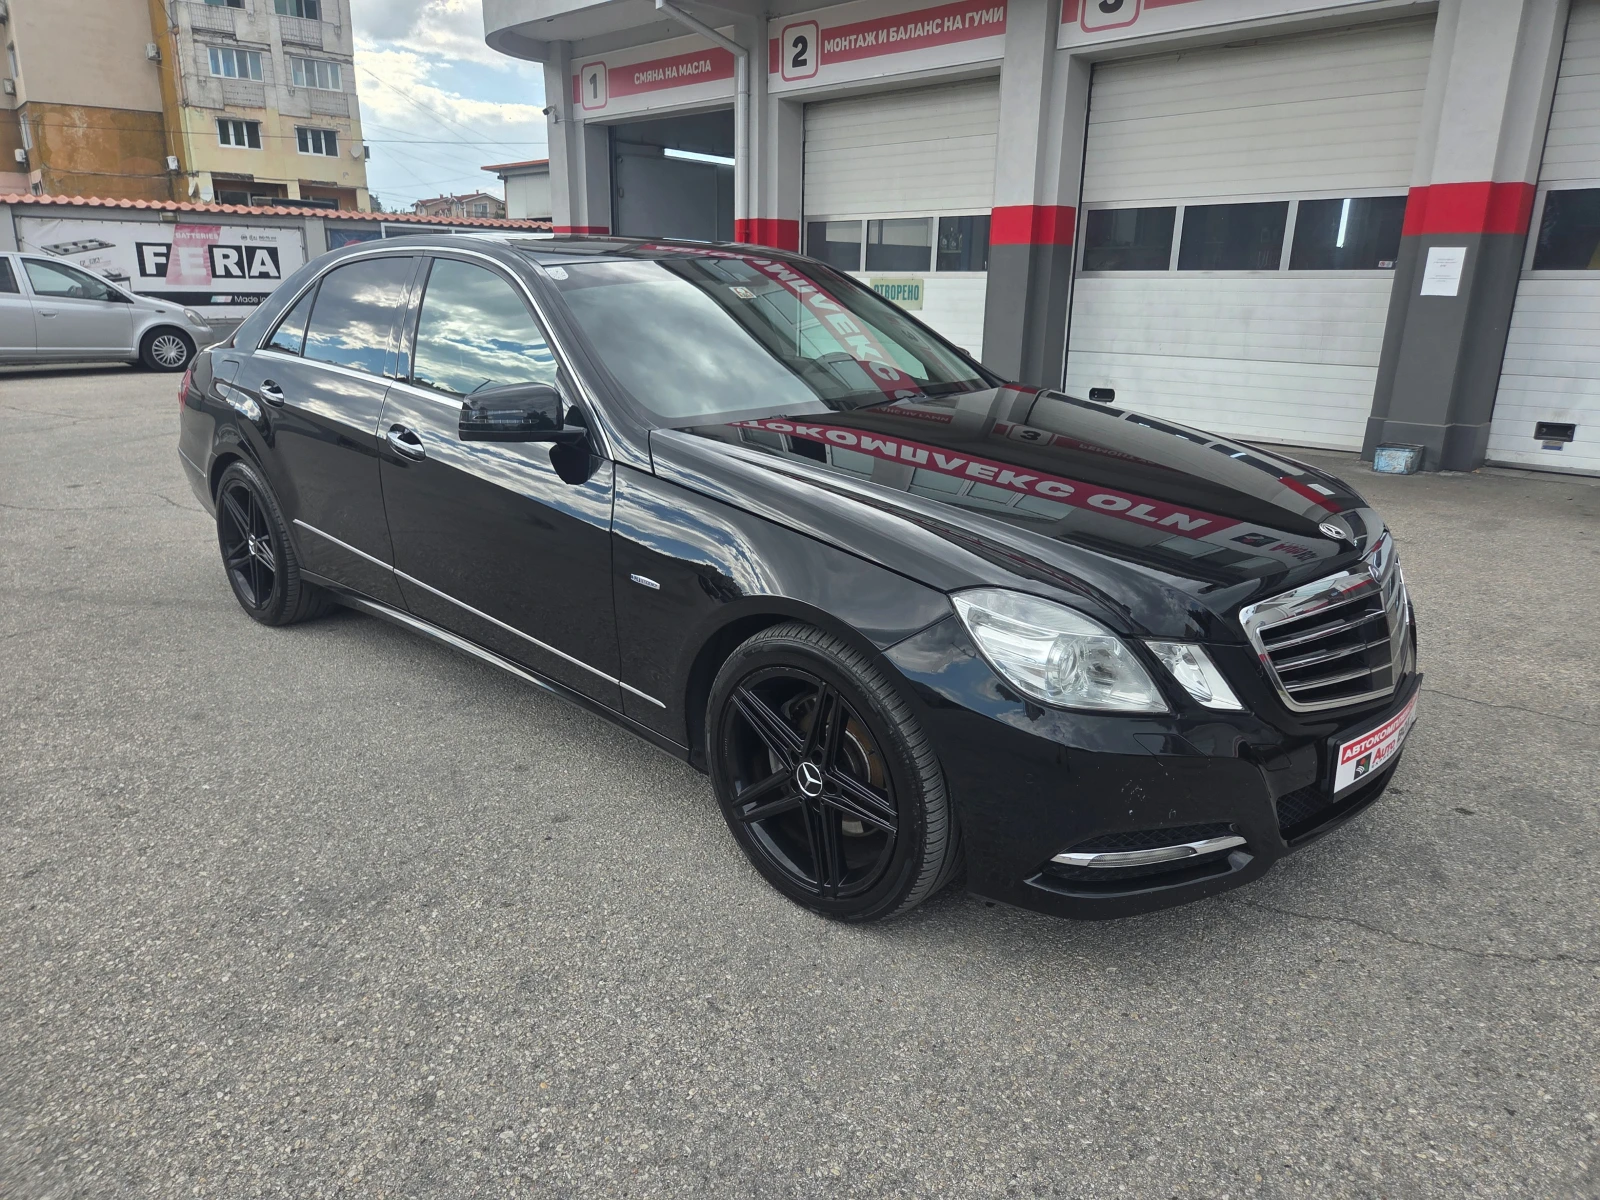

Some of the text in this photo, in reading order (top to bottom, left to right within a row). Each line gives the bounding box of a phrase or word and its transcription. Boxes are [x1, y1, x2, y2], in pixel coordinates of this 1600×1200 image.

[824, 6, 1004, 54] МОНТАЖ И БАЛАНС НА ГУМИ
[792, 35, 808, 68] 2
[634, 59, 712, 85] СМЯНА НА МАСЛА
[589, 73, 598, 99] 1
[175, 231, 220, 240] BATTERIES
[142, 245, 280, 277] FERA
[234, 295, 259, 303] Made
[873, 284, 920, 301] ОТВОРЕНО
